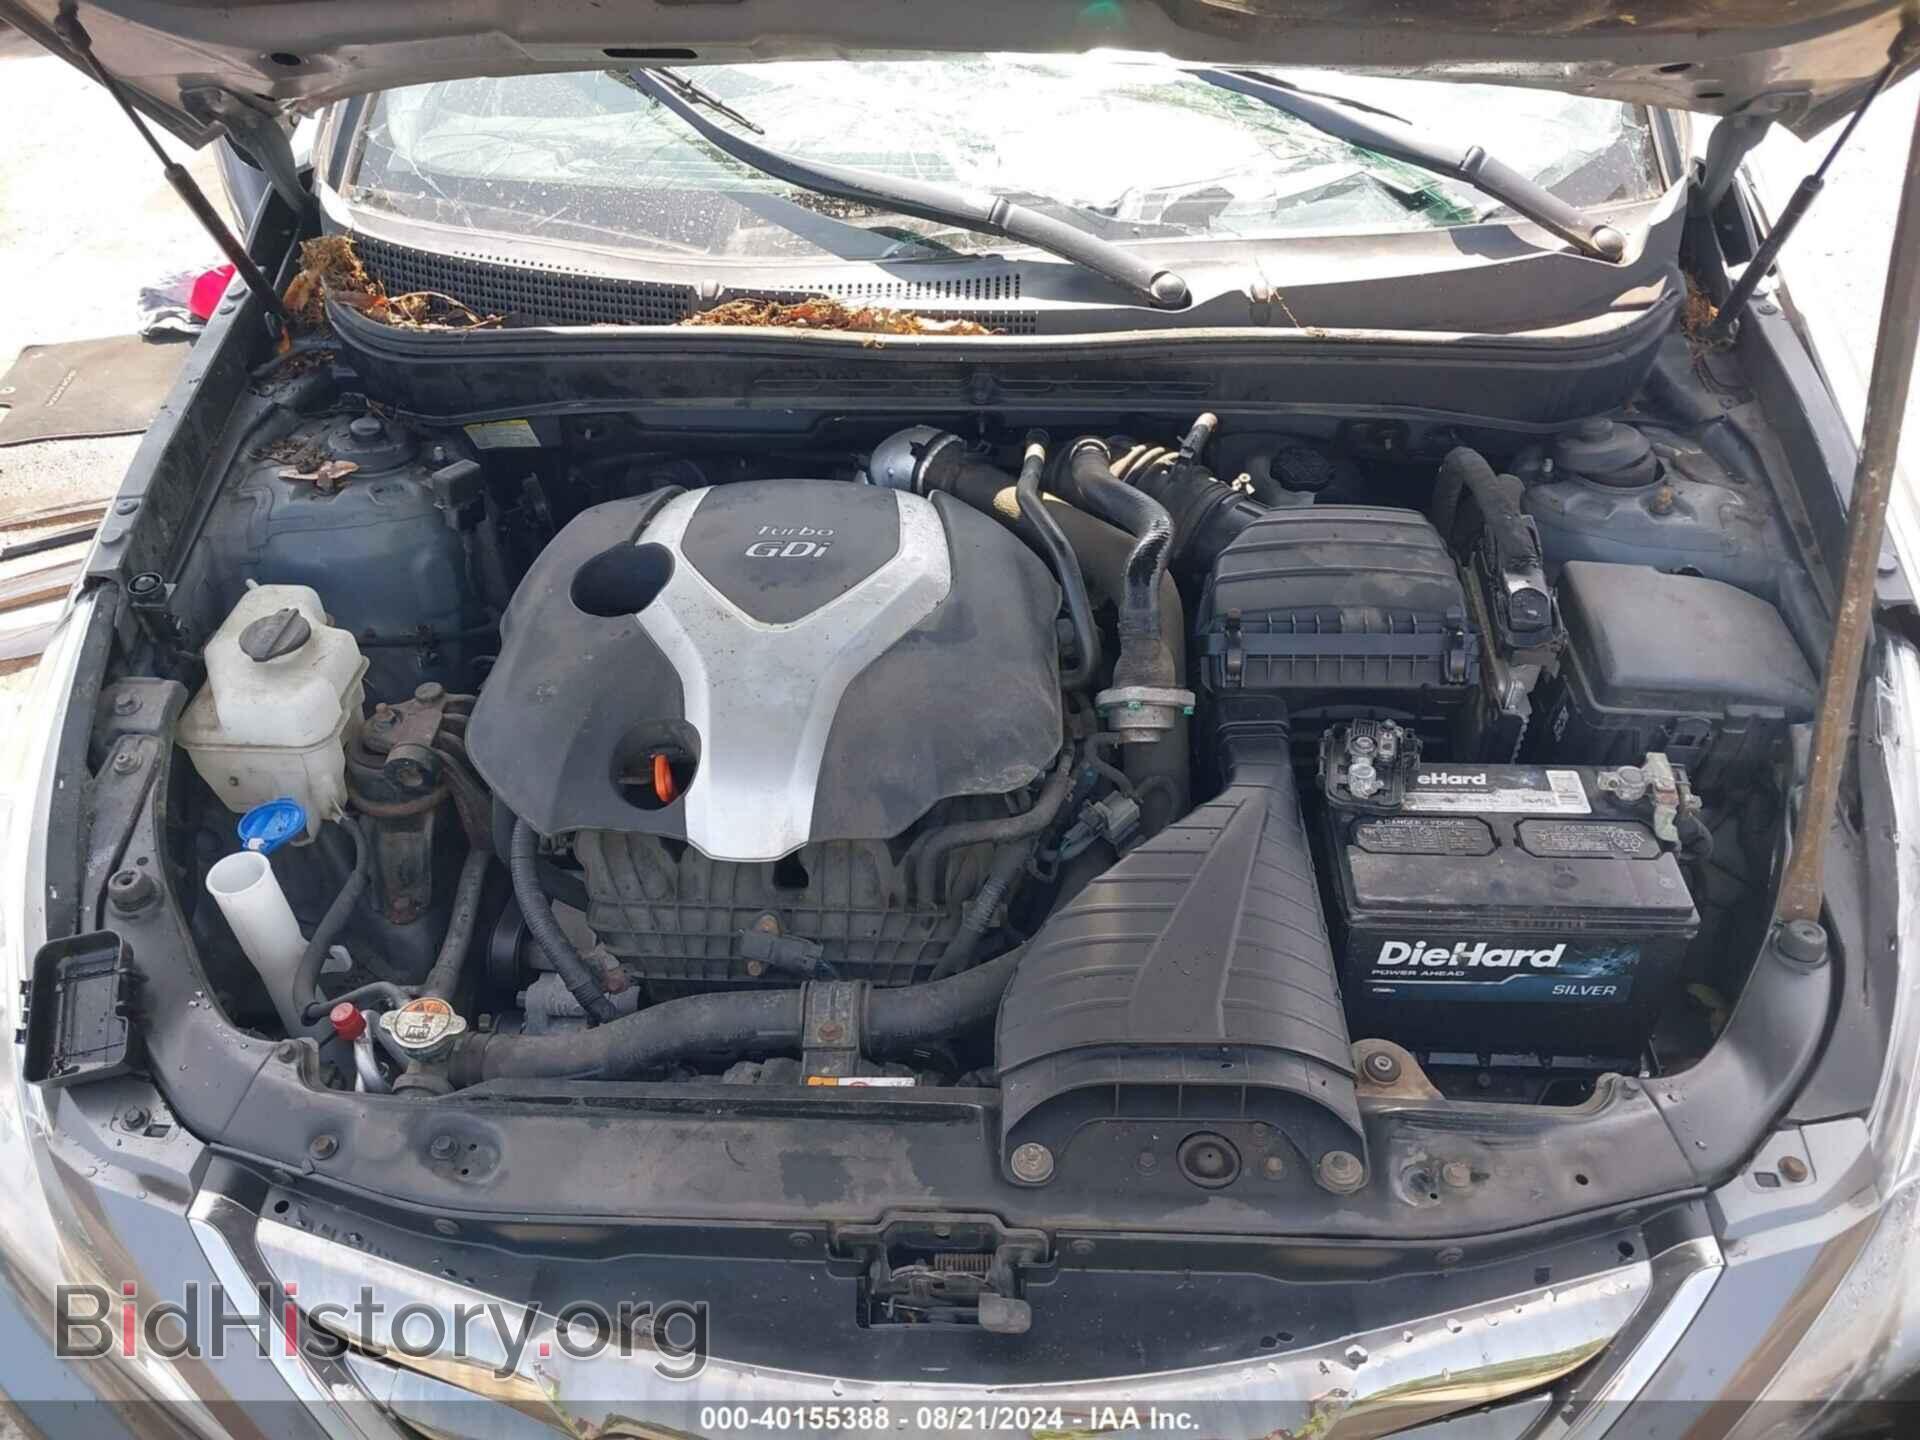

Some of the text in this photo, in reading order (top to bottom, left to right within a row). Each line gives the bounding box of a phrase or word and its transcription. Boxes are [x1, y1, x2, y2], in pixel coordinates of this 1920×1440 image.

[757, 525, 835, 537] Turbo
[744, 541, 832, 558] GDi
[1416, 772, 1488, 785] eHard
[1376, 940, 1568, 968] DieHard
[1371, 969, 1418, 977] POWER
[1552, 984, 1617, 996] SILVER
